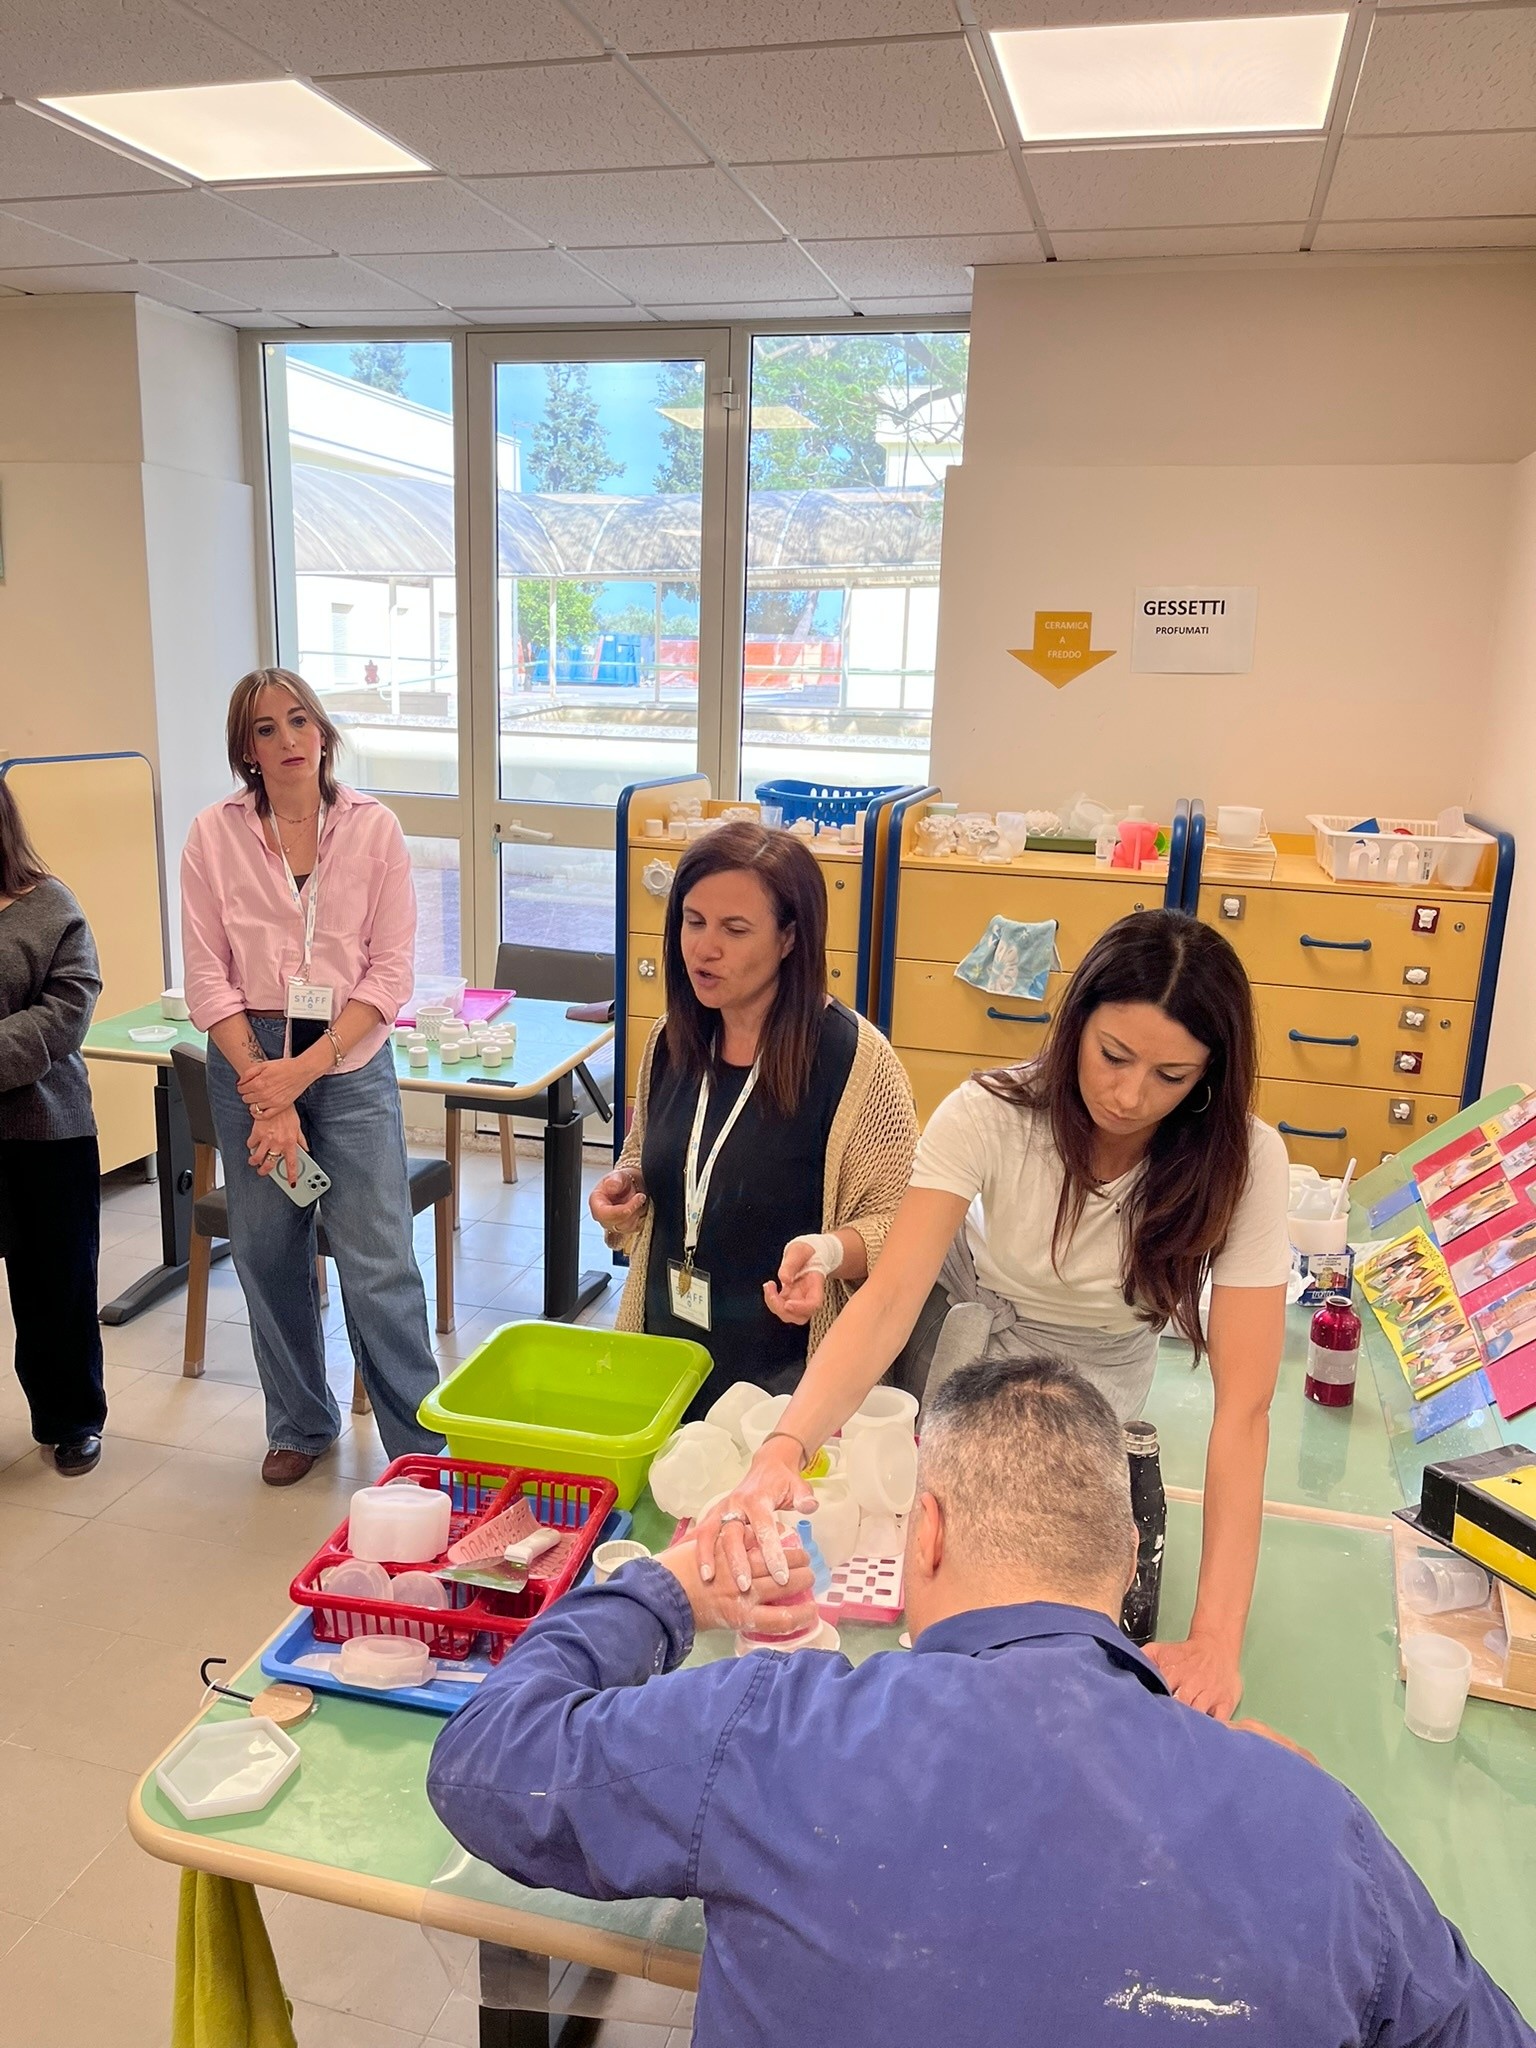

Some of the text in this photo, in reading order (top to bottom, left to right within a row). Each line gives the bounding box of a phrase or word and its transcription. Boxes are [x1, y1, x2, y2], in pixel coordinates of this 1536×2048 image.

[1143, 600, 1225, 615] GESSETTI
[1044, 621, 1089, 630] CERAMICA
[1155, 626, 1209, 635] PROFUMATI
[1059, 636, 1066, 644] A
[1047, 650, 1082, 659] FREDDO
[294, 994, 327, 1004] STAFF
[675, 1286, 704, 1304] SAFF
